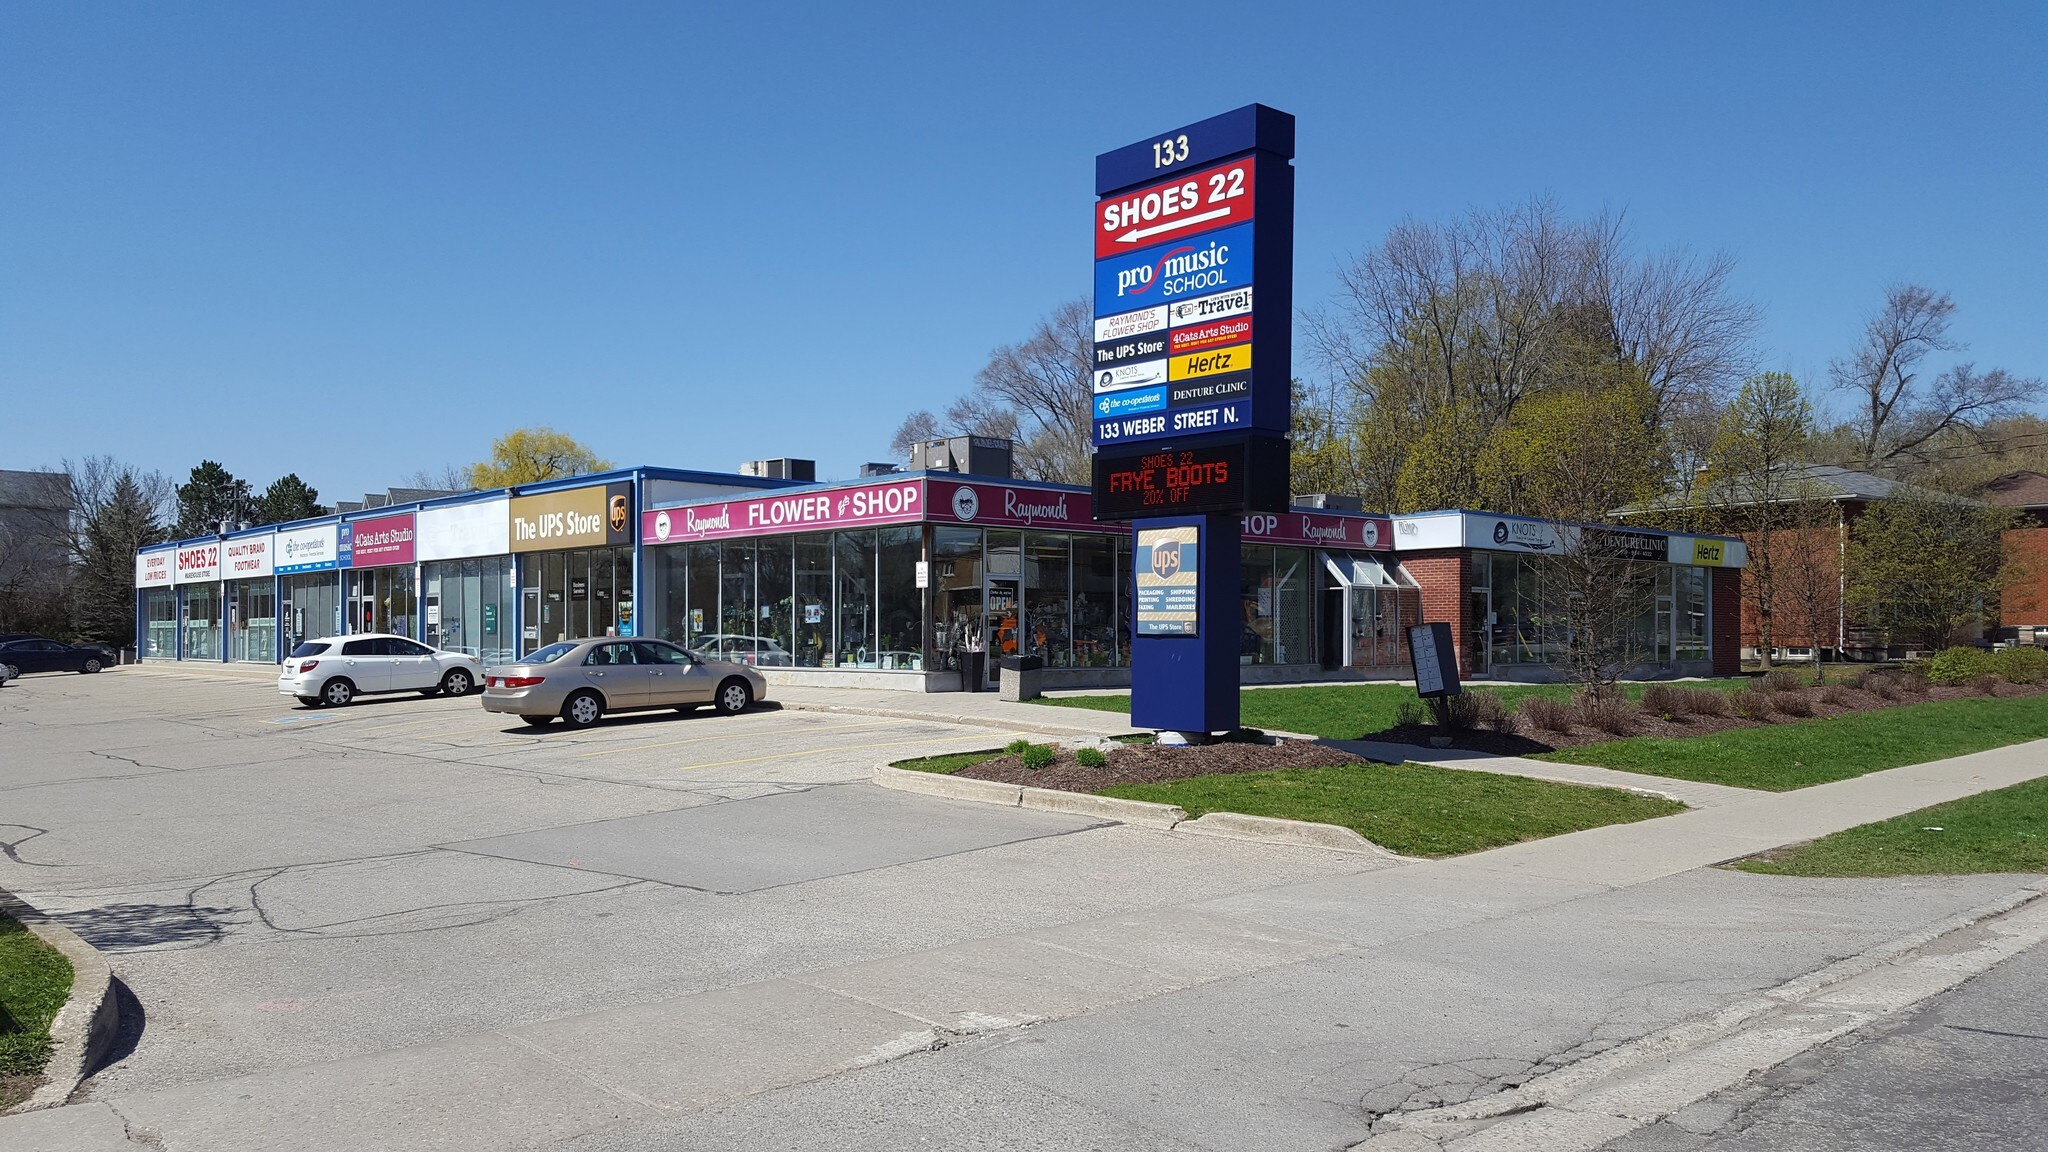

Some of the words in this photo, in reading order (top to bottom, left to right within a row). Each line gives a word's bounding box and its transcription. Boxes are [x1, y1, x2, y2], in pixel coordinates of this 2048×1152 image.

[1153, 134, 1190, 169] 133
[1103, 181, 1199, 232] SHOES
[1208, 168, 1245, 204] 22
[1117, 265, 1152, 297] pro
[1164, 241, 1229, 278] music
[1163, 268, 1228, 296] SCHOOL
[1198, 291, 1249, 316] Travel
[1109, 309, 1156, 328] RAYMOND'S
[1103, 324, 1136, 339] FLOWER
[1137, 319, 1159, 332] SHOP
[1173, 332, 1198, 344] 4Cats
[1198, 327, 1219, 339] Arts
[1220, 322, 1249, 335] Studio
[1097, 349, 1114, 362] The
[1116, 343, 1135, 359] UPS
[1137, 341, 1163, 355] Store
[1115, 365, 1138, 378] KNOTS
[1187, 353, 1232, 374] Hertz
[1110, 399, 1121, 408] the
[1122, 393, 1160, 407] co-operators
[1173, 385, 1215, 401] DENTURE
[1215, 381, 1247, 394] CLINIC
[1100, 422, 1120, 440] 133
[1122, 416, 1166, 437] WEBER
[1173, 408, 1219, 431] STREET
[1223, 406, 1239, 424] N.
[1141, 453, 1174, 470] SHOES
[1180, 451, 1194, 465] 22
[1109, 469, 1155, 493] FRYE
[1166, 461, 1228, 488] BOOTS
[1143, 489, 1164, 505] 20%
[1170, 486, 1190, 502] OFF
[611, 505, 625, 526] ups
[687, 503, 730, 538] Raymond's
[749, 496, 831, 526] FLOWER
[852, 487, 918, 516] SHOP
[1005, 489, 1068, 526] Raymond's
[341, 527, 350, 540] pro
[514, 517, 536, 540] The
[539, 512, 564, 538] UPS
[566, 510, 600, 535] Store
[1240, 515, 1278, 535] HOP
[1302, 515, 1346, 545] Raymond's
[1511, 522, 1536, 537] KNOTS
[339, 540, 352, 552] music
[355, 533, 374, 547] 4Cats
[374, 531, 389, 545] Arts
[390, 527, 413, 543] Studio
[1640, 537, 1666, 551] CLINIC
[179, 549, 206, 571] SHOES
[207, 547, 217, 567] 22
[228, 545, 249, 557] QUALITY
[249, 542, 265, 555] BRAND
[1696, 544, 1720, 561] Hertz
[146, 556, 165, 568] EVERYDAY
[234, 559, 261, 571] FOOTWEAR
[1154, 550, 1178, 575] ups
[144, 572, 153, 581] LOW
[990, 596, 1012, 610] OPEN
